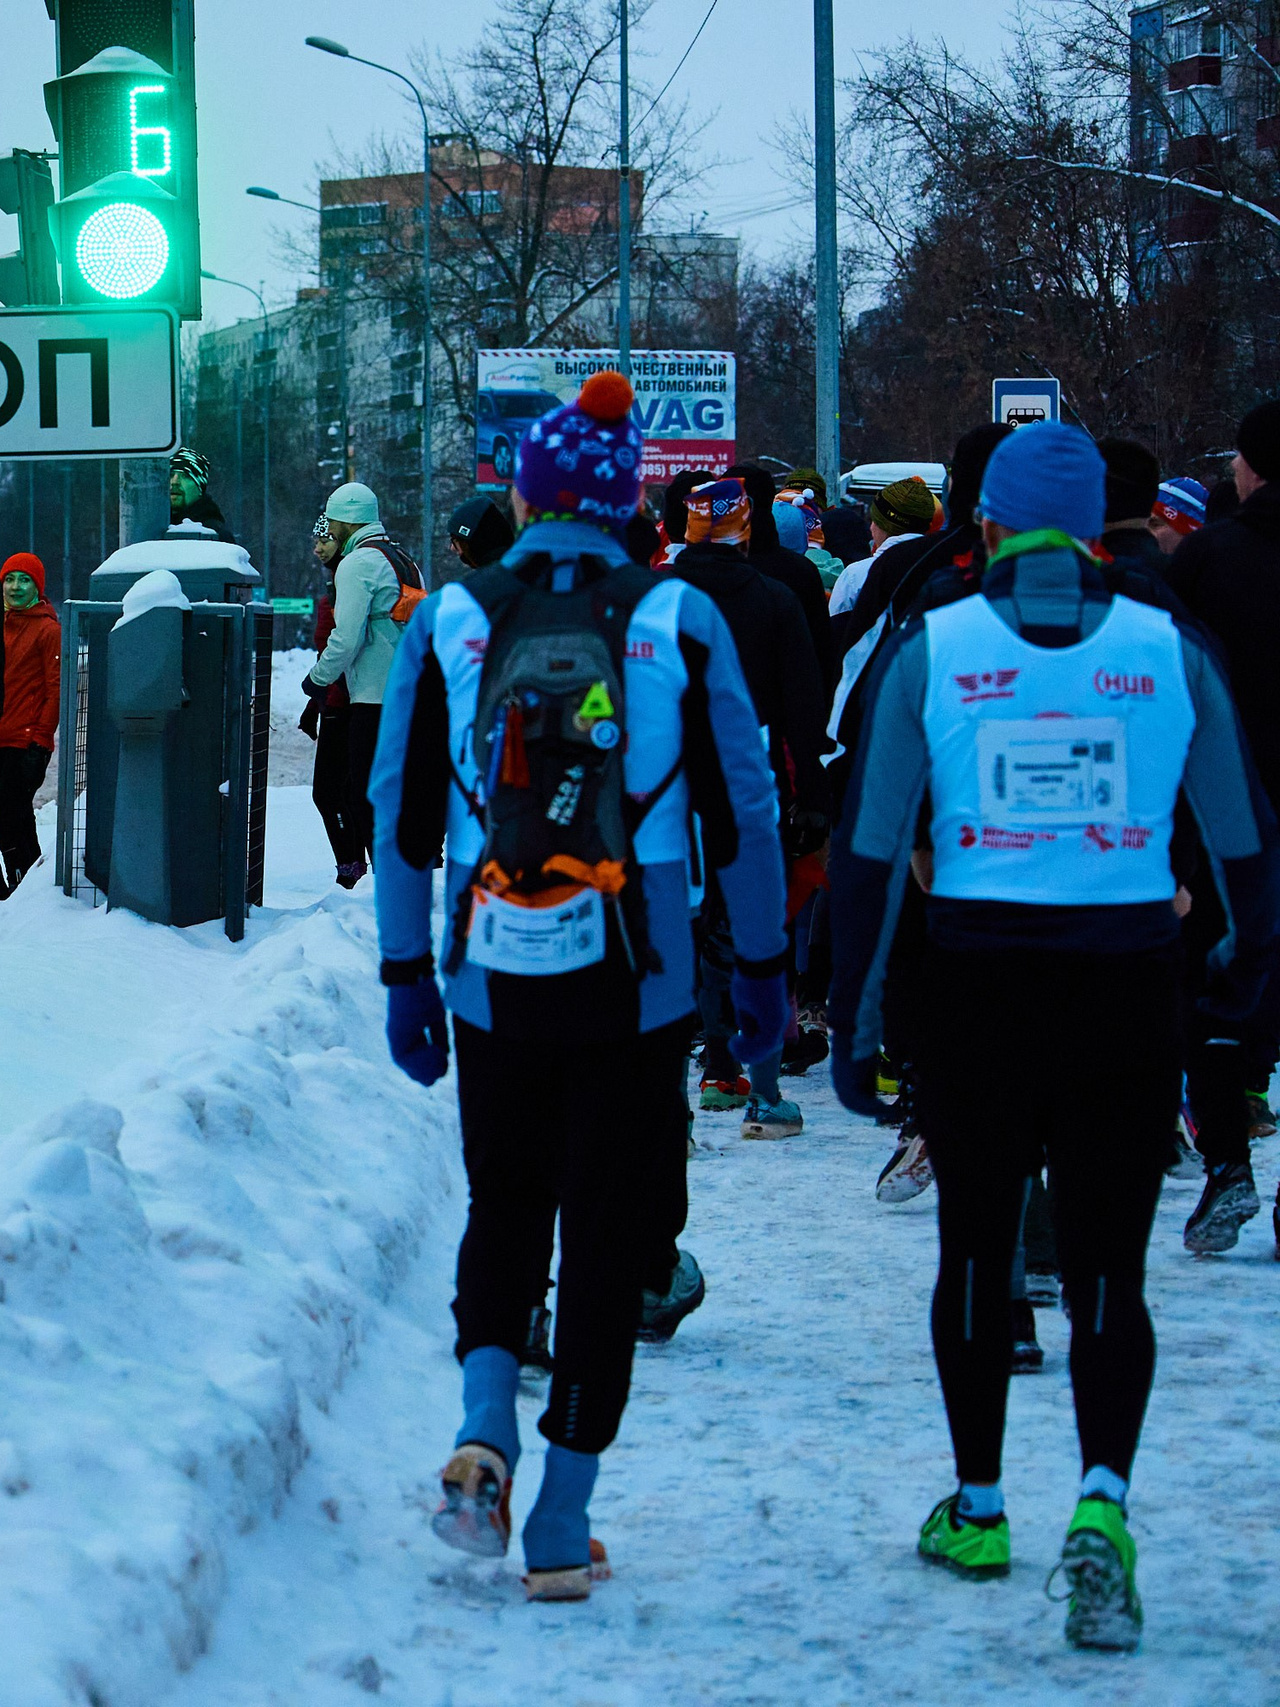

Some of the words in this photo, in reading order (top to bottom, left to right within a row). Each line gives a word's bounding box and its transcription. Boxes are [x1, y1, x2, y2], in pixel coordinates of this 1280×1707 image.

[129, 85, 171, 177] 6
[555, 361, 727, 376] ВЫСОКОЧЕСТВЕННЫЙ
[635, 380, 727, 393] АВТОМОБИЛЕЙ
[633, 399, 724, 431] VAG
